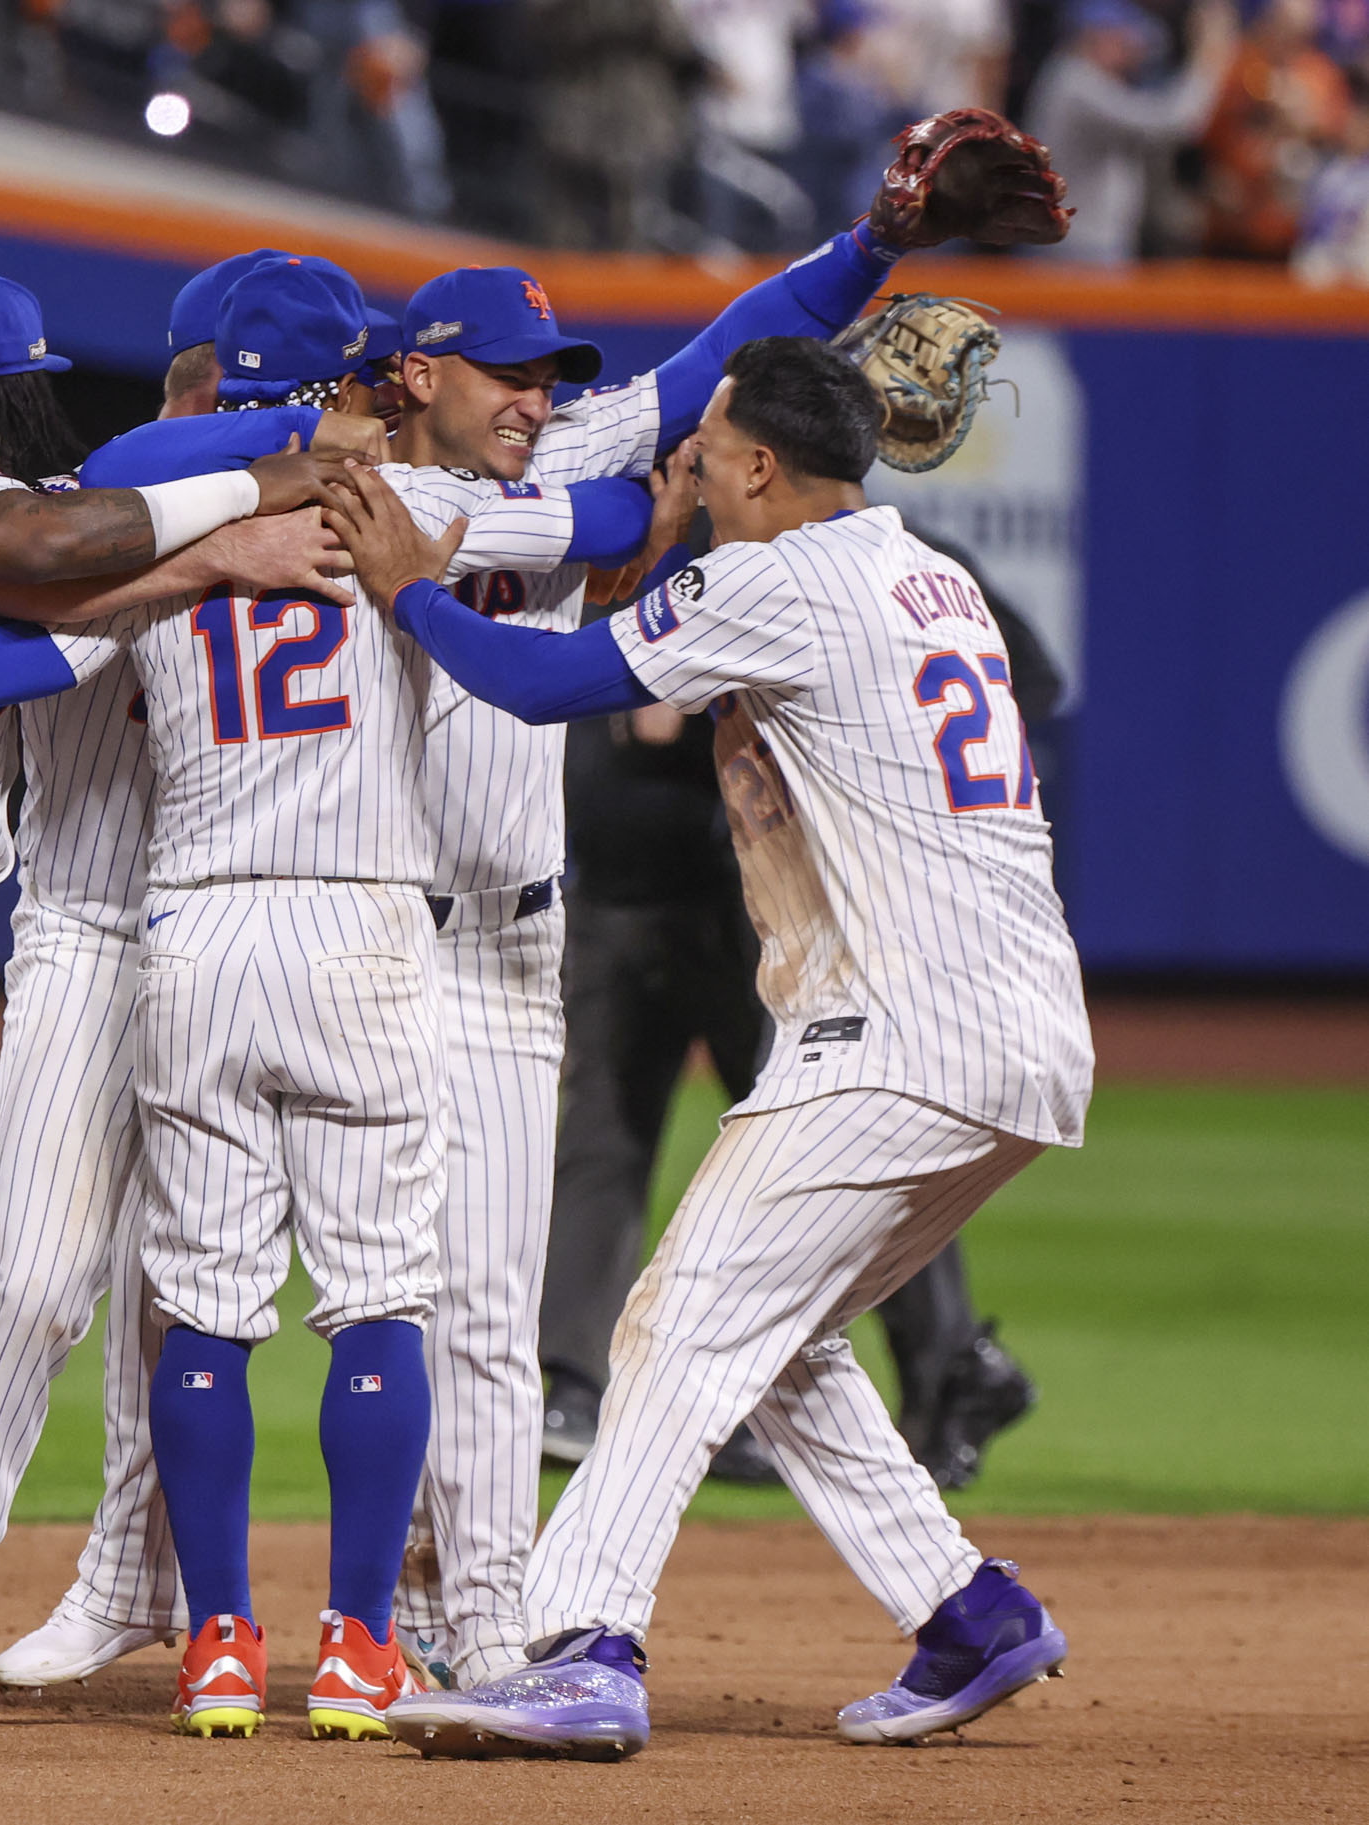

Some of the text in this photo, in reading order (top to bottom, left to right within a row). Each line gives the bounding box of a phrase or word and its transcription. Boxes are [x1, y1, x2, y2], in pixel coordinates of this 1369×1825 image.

[674, 570, 703, 600] 24
[890, 571, 990, 631] VIENTOS
[191, 579, 352, 745] 12
[912, 650, 1035, 814] 27
